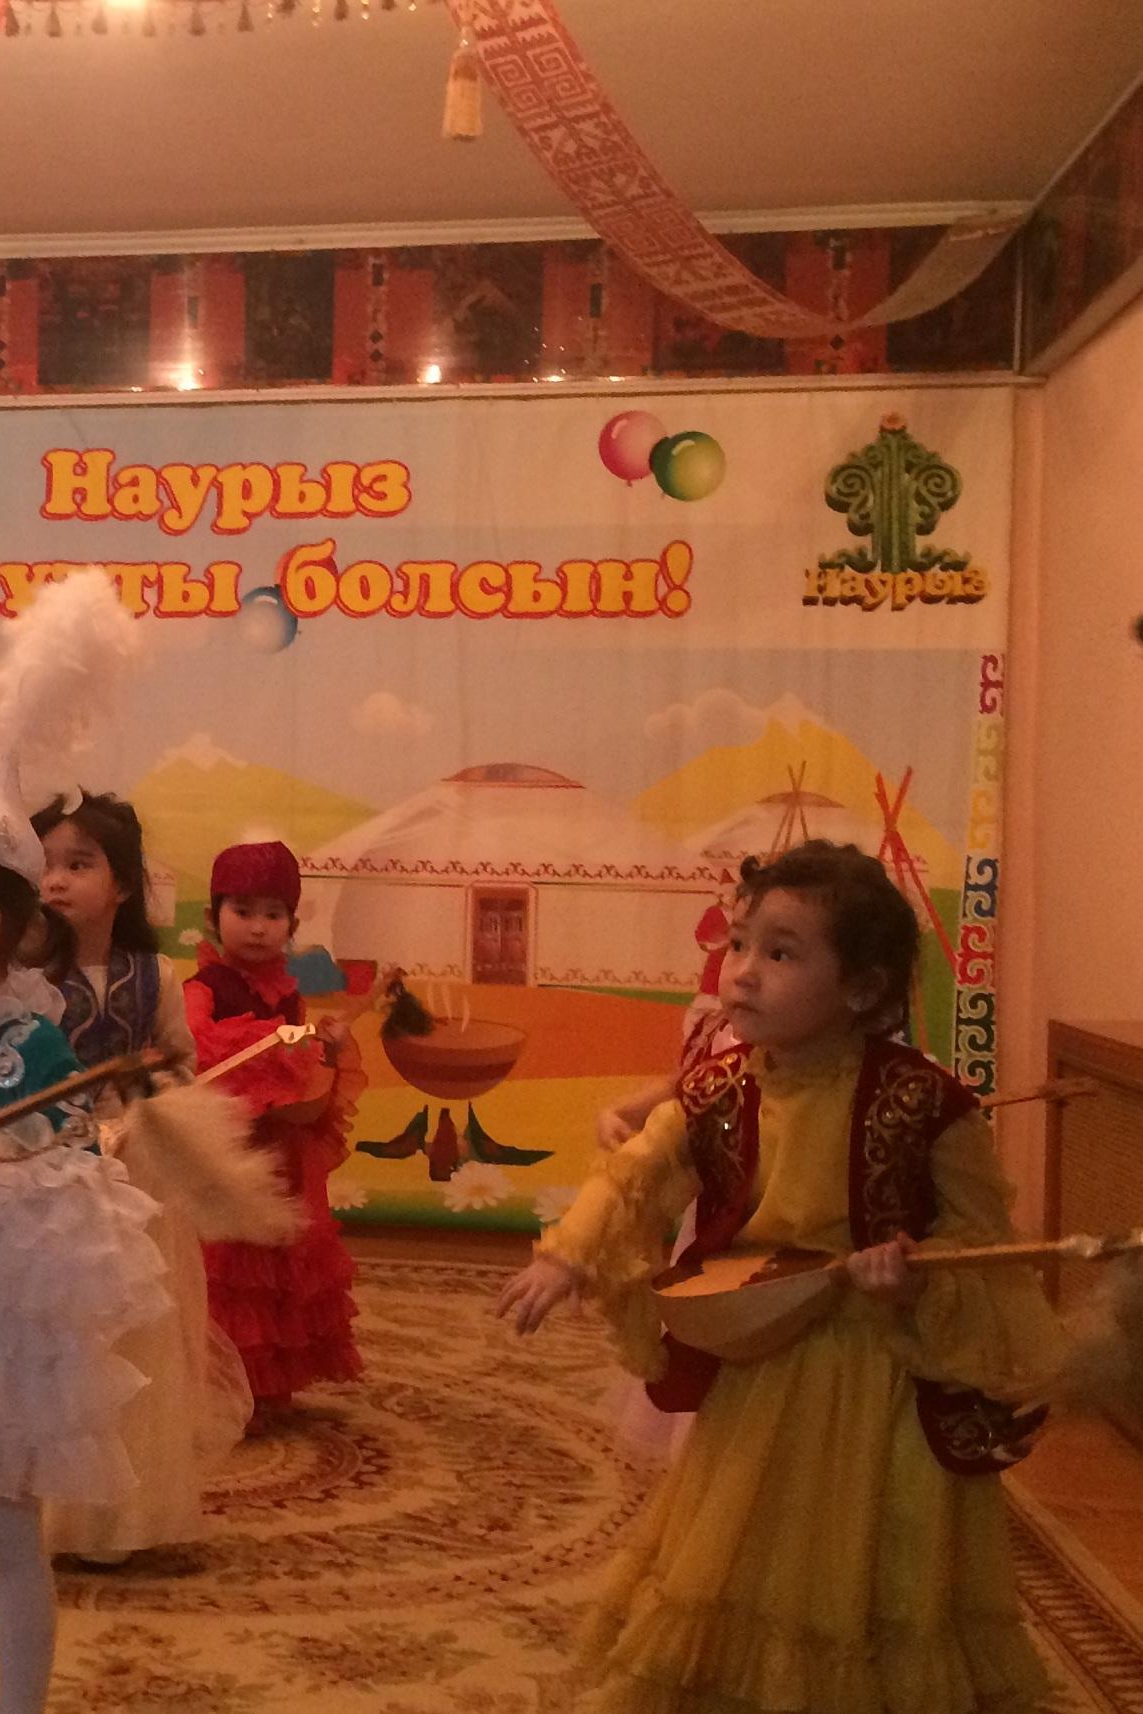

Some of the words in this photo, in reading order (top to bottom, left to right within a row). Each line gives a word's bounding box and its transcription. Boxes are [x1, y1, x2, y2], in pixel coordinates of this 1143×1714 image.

[41, 448, 411, 535] Наурыз
[281, 538, 693, 619] болсын!
[802, 567, 990, 612] Наурыз
